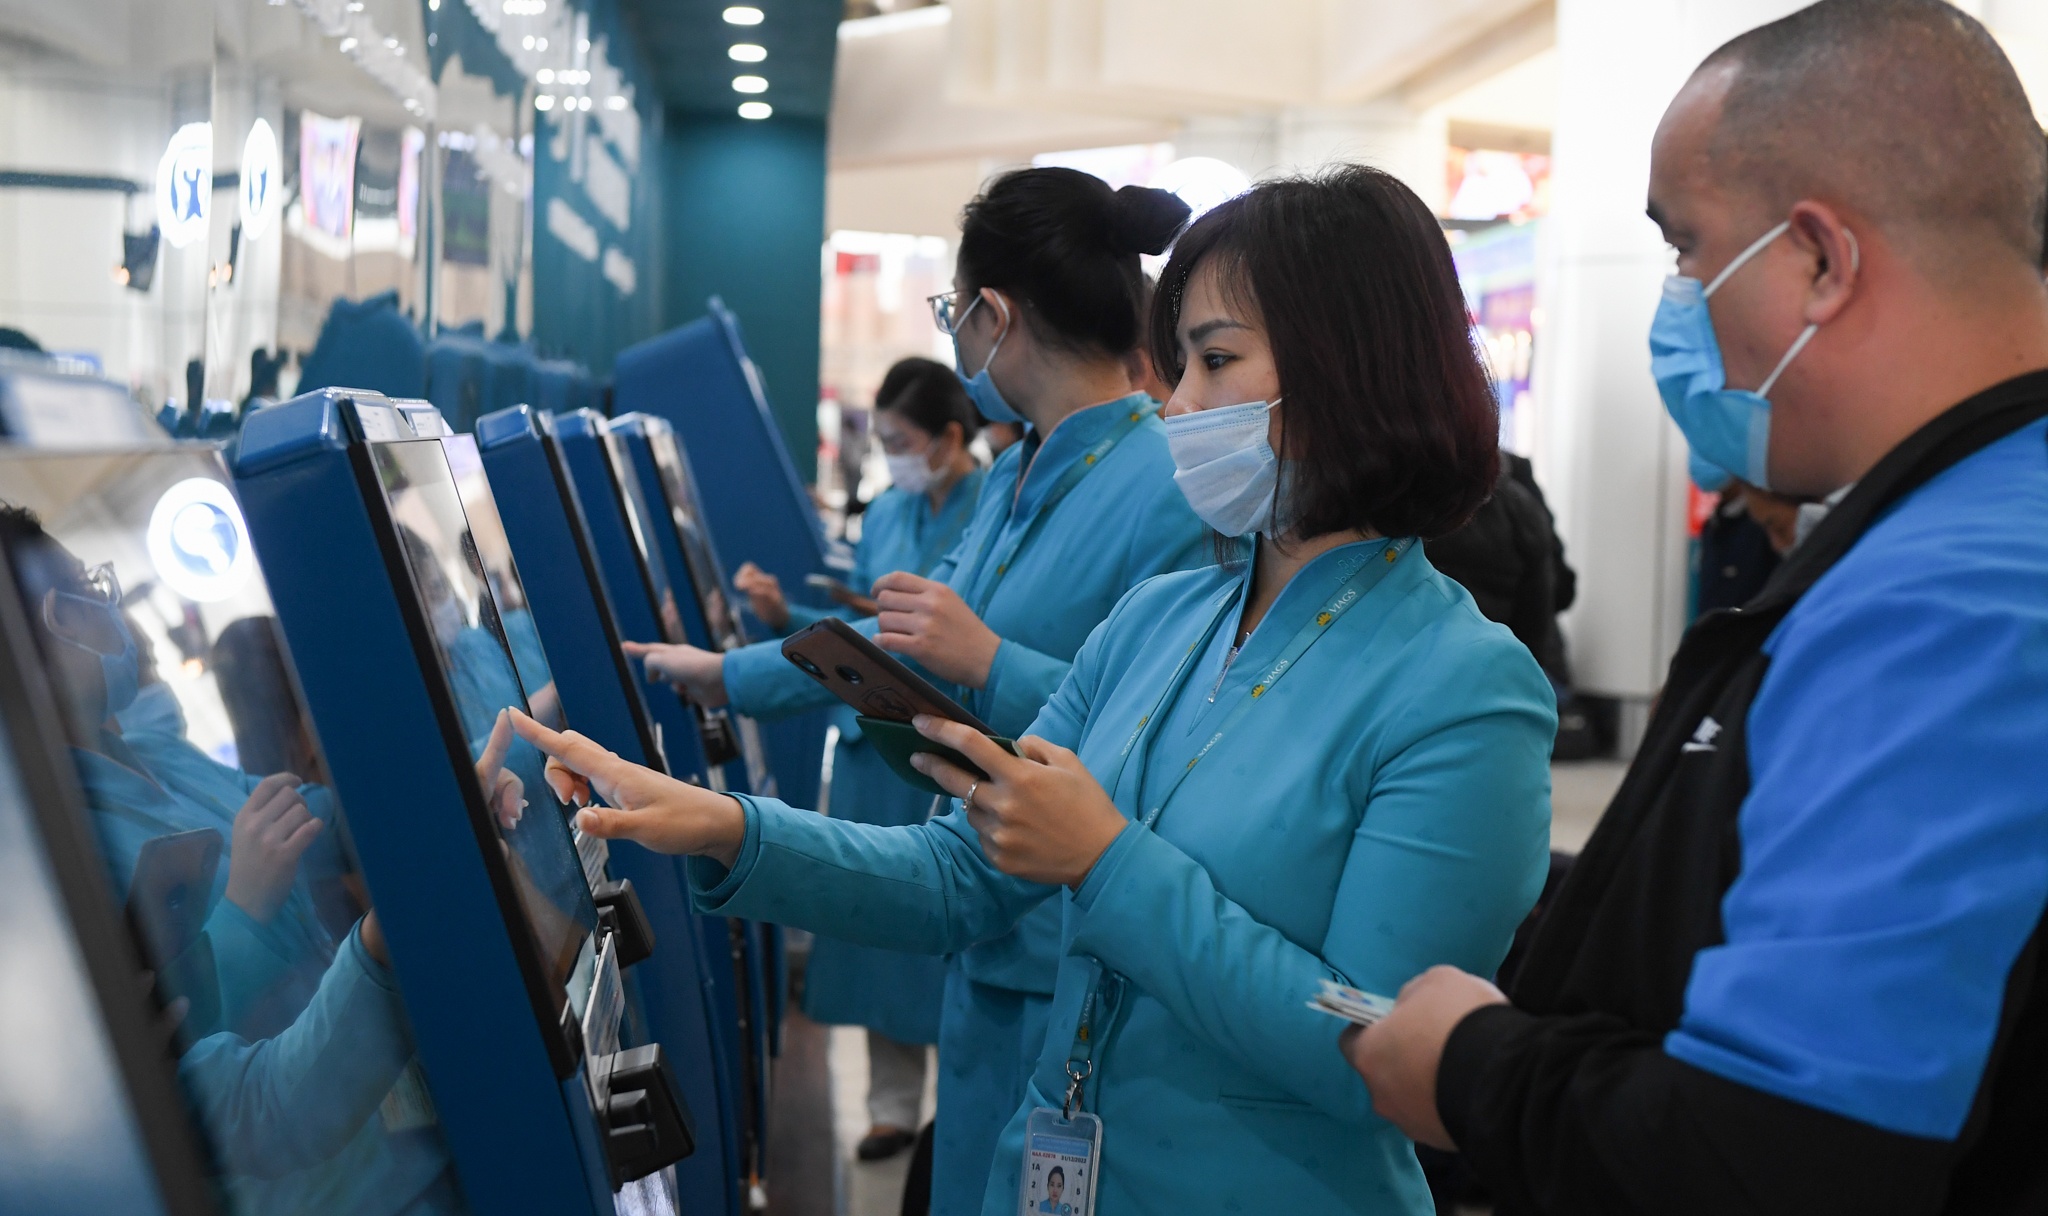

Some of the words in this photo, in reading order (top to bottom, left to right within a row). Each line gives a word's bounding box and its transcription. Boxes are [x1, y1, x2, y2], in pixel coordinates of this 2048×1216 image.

[1329, 589, 1356, 613] VIAGS
[1263, 659, 1288, 684] VIAGS
[1198, 732, 1223, 756] VIAGS
[1032, 1163, 1040, 1171] 1A
[1077, 1168, 1083, 1177] 4
[1031, 1180, 1036, 1189] 2
[1029, 1200, 1034, 1208] 3
